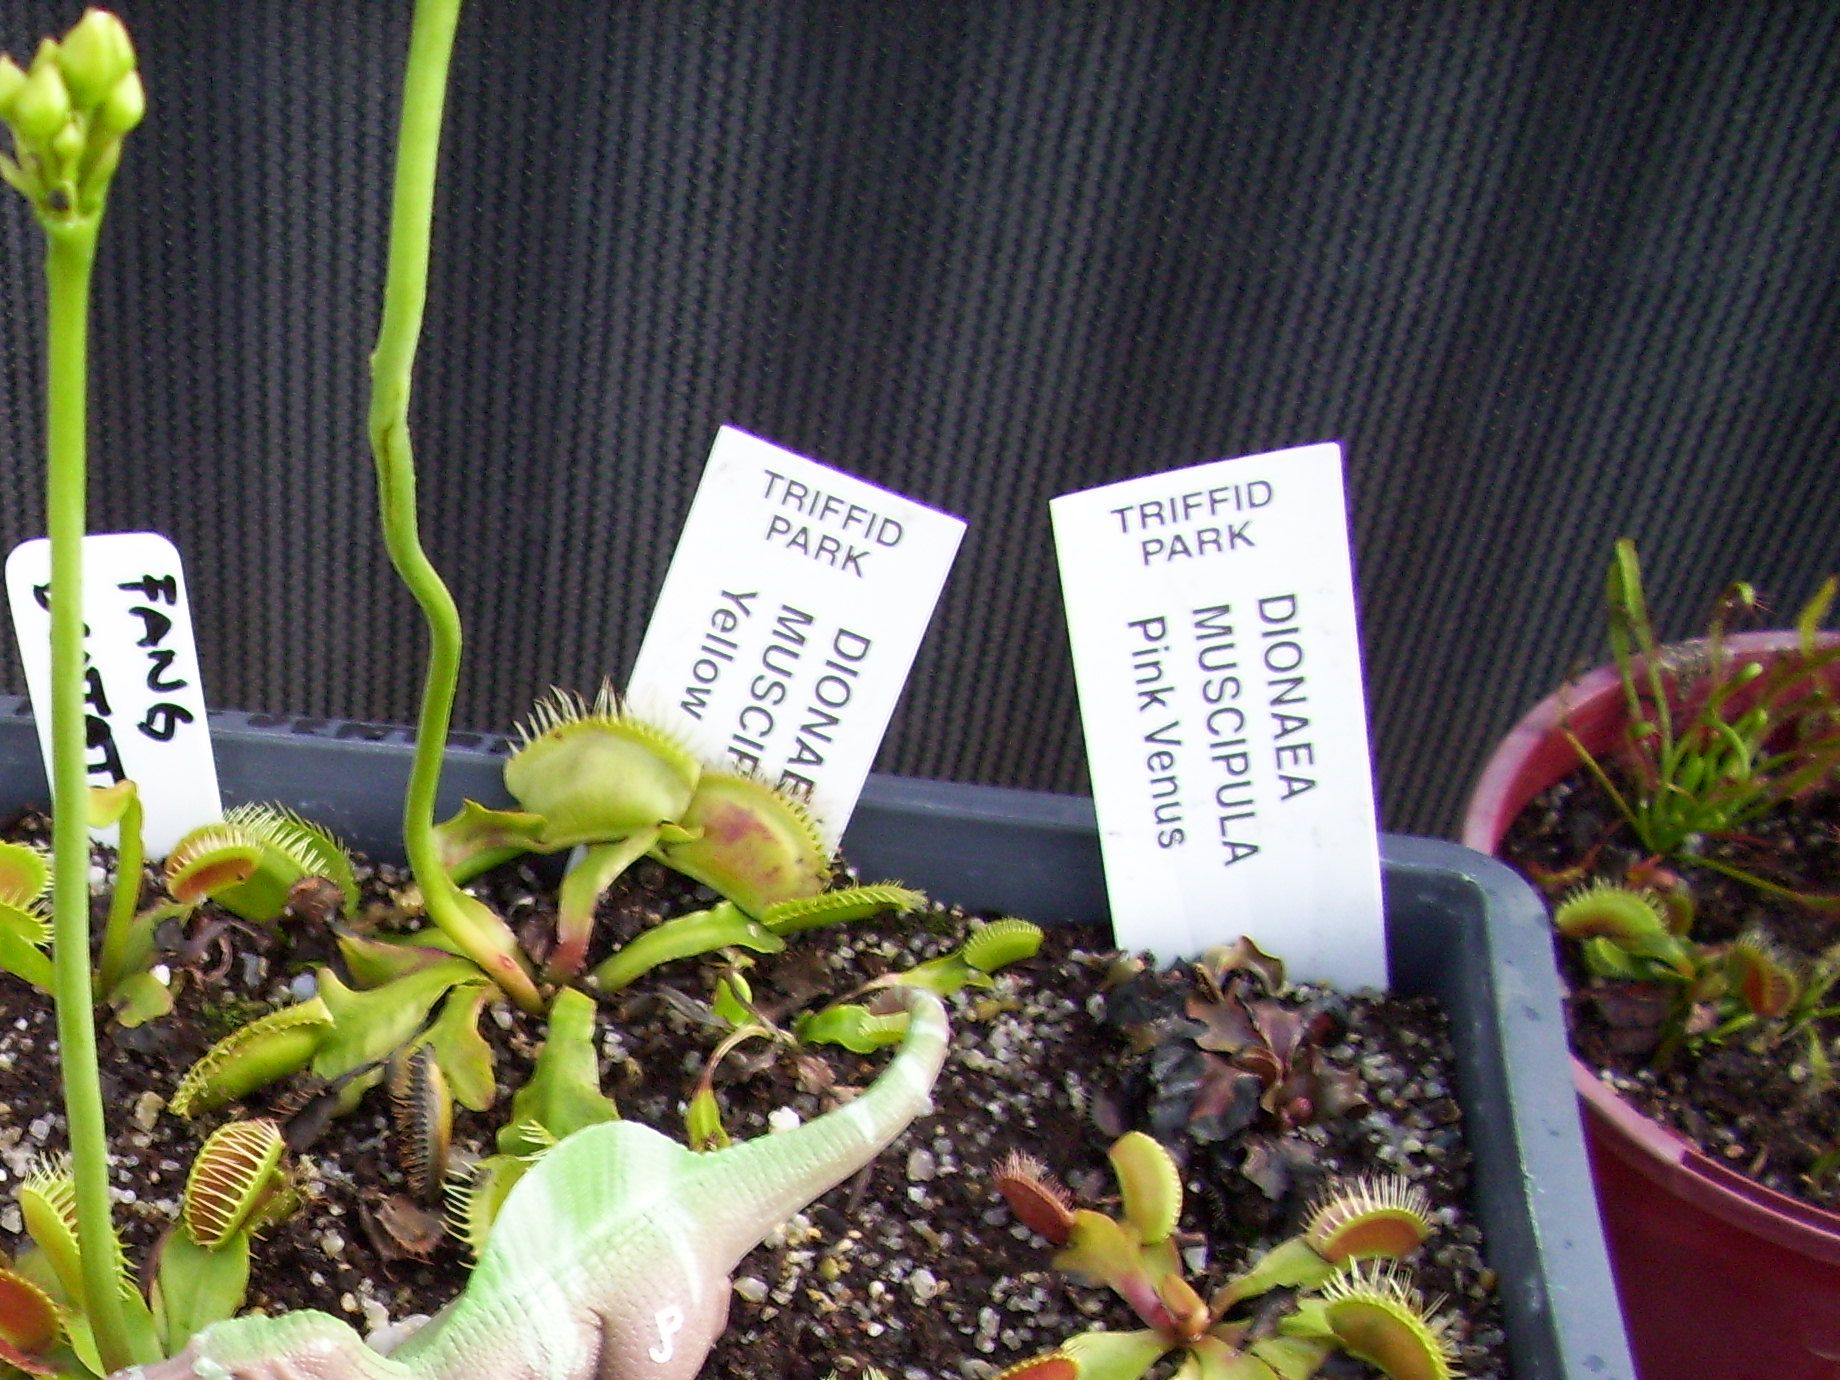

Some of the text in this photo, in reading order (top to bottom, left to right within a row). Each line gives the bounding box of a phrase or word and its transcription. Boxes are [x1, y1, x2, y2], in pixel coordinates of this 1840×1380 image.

[763, 469, 904, 548] TRIFFID
[766, 513, 872, 577] PARK
[1110, 479, 1274, 534] TRIFFID
[1141, 520, 1256, 566] PARK
[679, 587, 760, 721] Yellow
[727, 603, 816, 780] MUSCIP
[772, 627, 873, 804] DIONAE
[1258, 593, 1316, 801] DIONAEA
[1127, 615, 1187, 850] Pink Venus
[1192, 603, 1260, 867] MUSCIPULA
